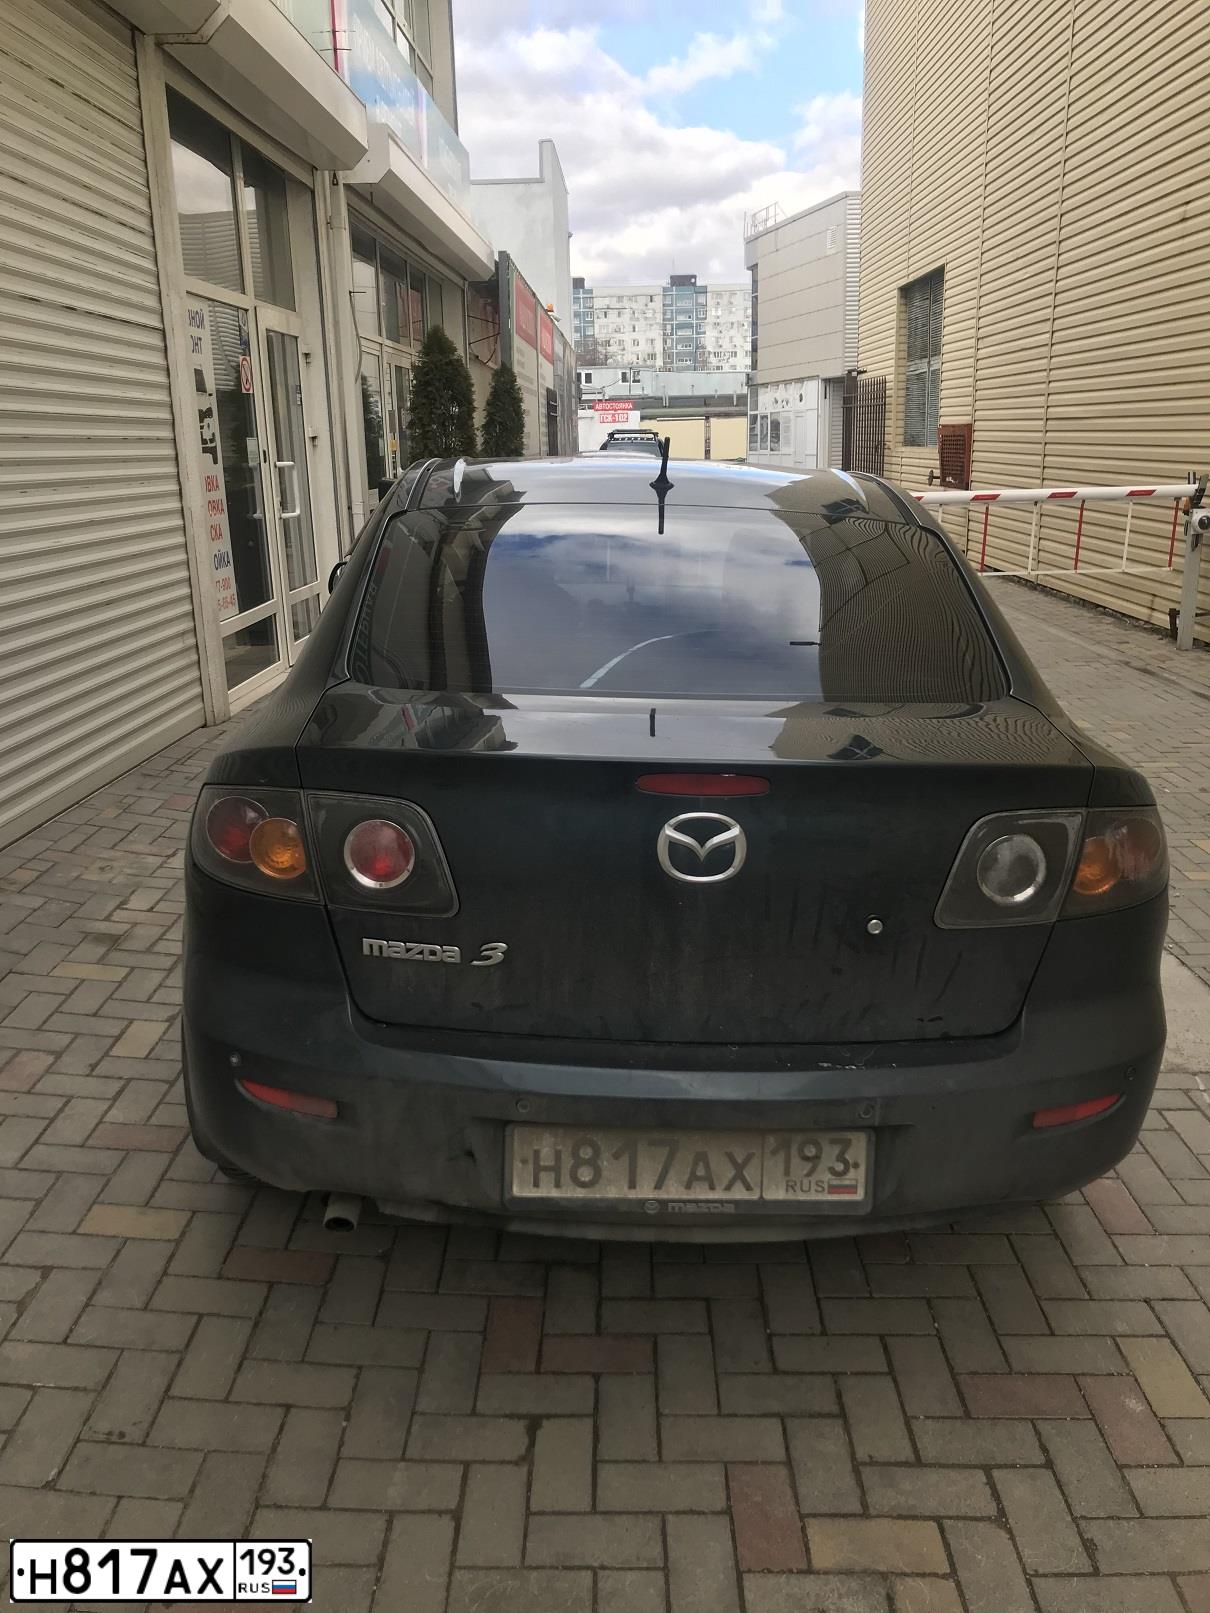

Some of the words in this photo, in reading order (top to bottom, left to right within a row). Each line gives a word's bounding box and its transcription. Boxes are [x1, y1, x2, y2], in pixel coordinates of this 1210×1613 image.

[595, 402, 633, 410] АВТОСТОЯНКА
[470, 942, 508, 966] 3
[532, 1137, 756, 1192] Н817АХ
[769, 1136, 853, 1178] 193
[785, 1179, 826, 1193] RUS
